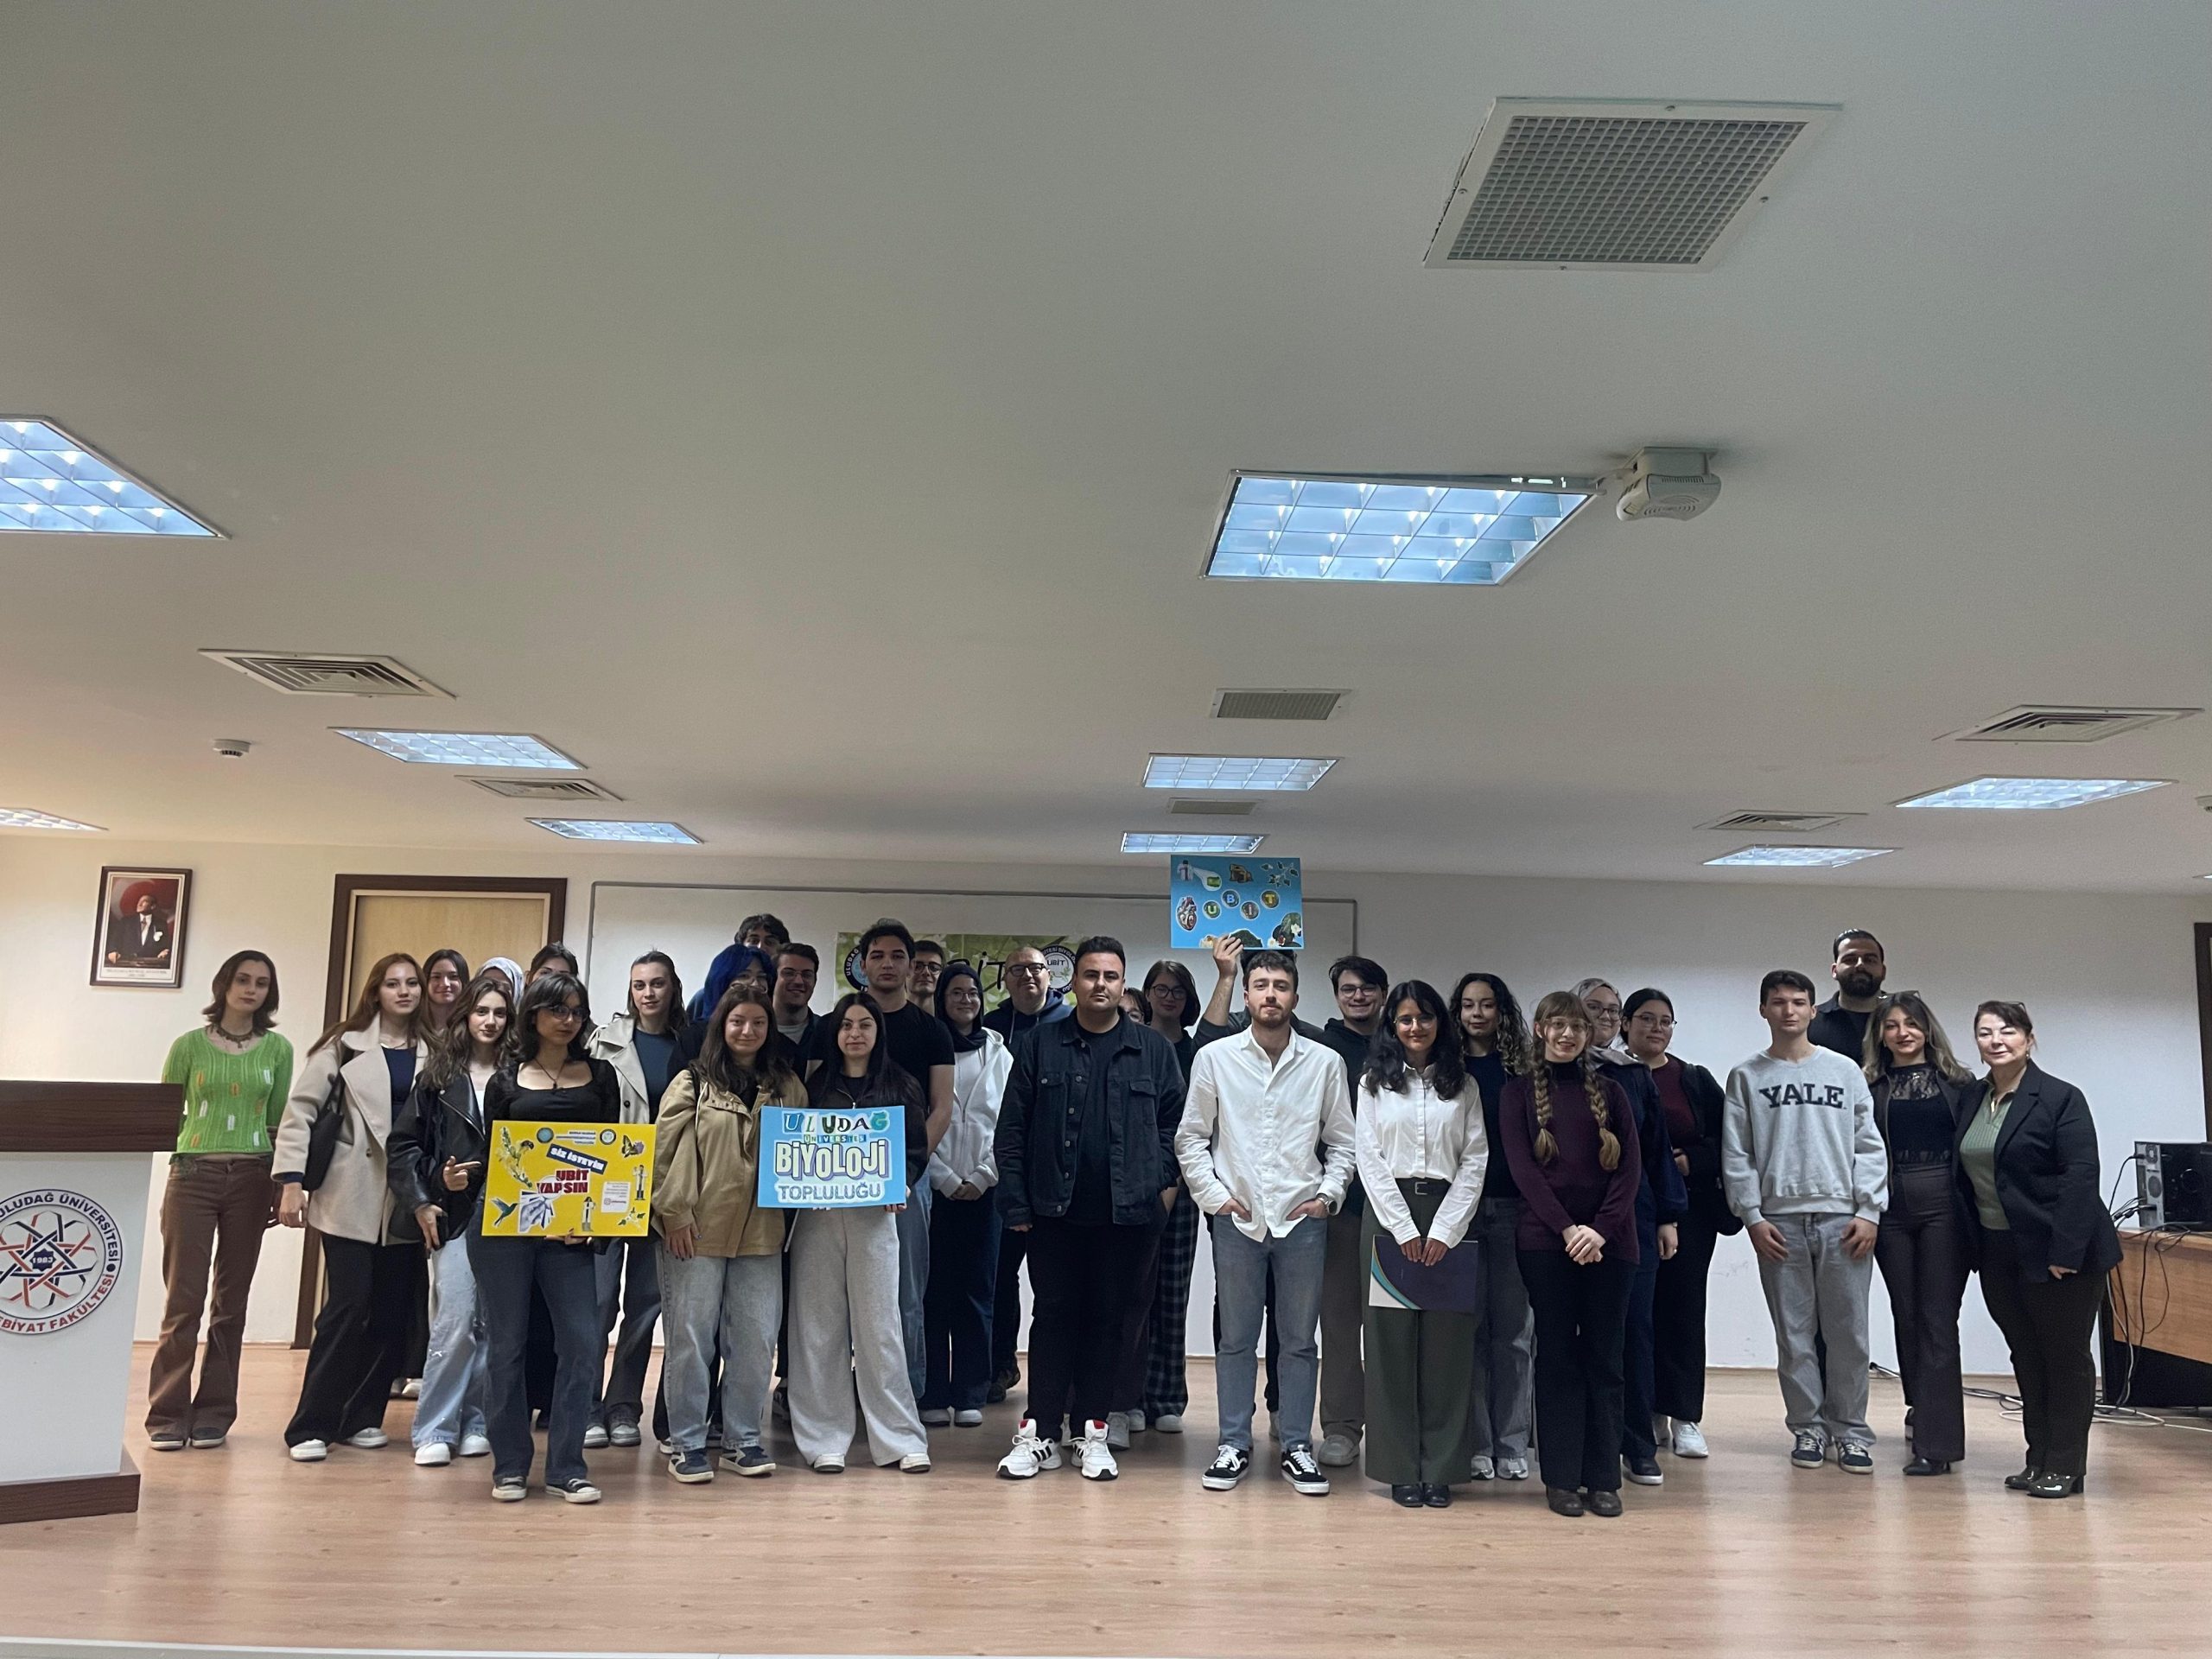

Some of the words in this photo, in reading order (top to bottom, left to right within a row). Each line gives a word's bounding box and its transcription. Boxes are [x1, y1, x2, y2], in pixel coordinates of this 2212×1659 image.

[1758, 1083, 1844, 1109] YALE
[775, 1139, 889, 1181] BİYOLOJİ
[778, 1182, 881, 1200] TOPLULUĞU
[60, 1193, 119, 1262] ÜNİVERSİTESİ
[49, 1274, 115, 1329] FAKÜLTESİ
